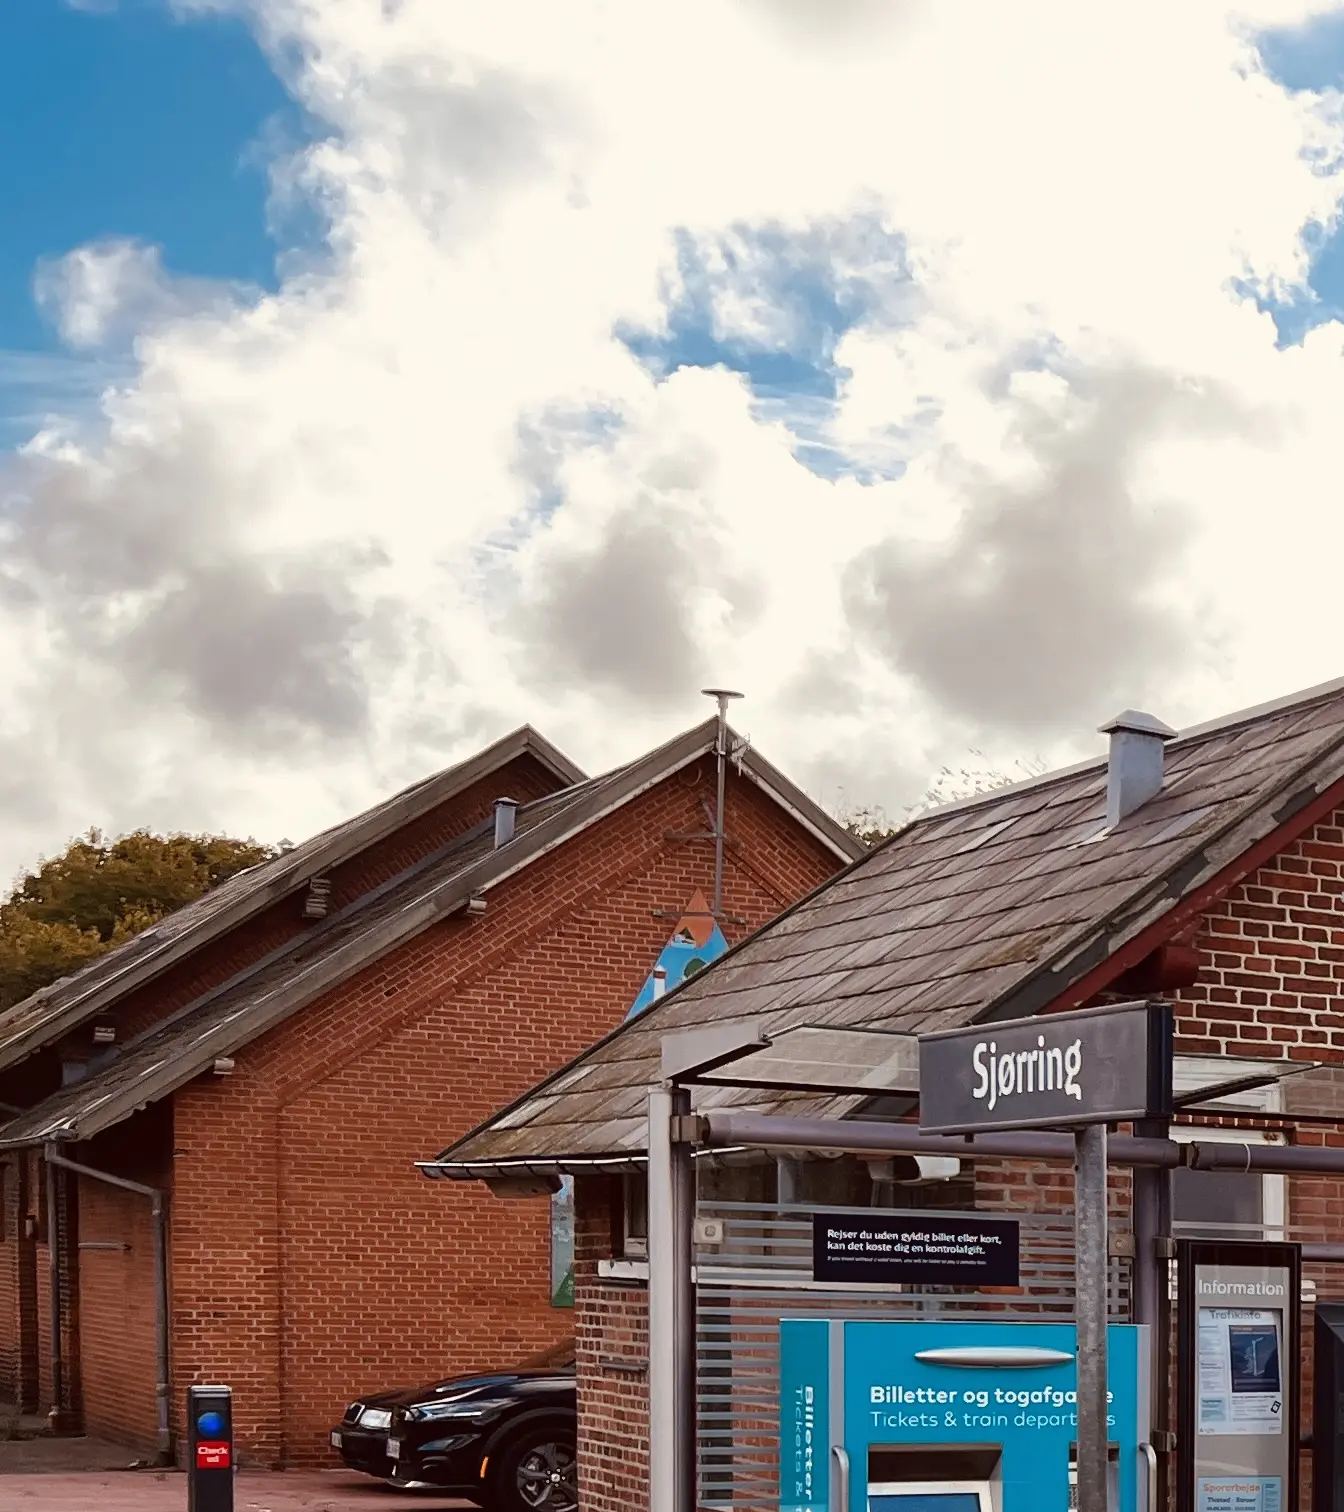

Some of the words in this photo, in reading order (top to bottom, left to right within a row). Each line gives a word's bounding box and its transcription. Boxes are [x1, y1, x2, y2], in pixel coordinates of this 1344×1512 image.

[973, 1035, 1081, 1110] Sjørring
[827, 1229, 857, 1240] Rejser
[859, 1230, 872, 1239] du
[874, 1231, 898, 1240] uden
[901, 1232, 930, 1242] gyldig
[827, 1241, 845, 1250] kan
[847, 1241, 863, 1251] det
[866, 1242, 892, 1252] koste
[894, 1243, 910, 1253] dig
[1199, 1279, 1284, 1296] Information
[870, 1386, 957, 1404] Billetter
[963, 1390, 989, 1407] og
[994, 1386, 1113, 1408] togafgae
[870, 1411, 938, 1427] Tickets
[944, 1411, 958, 1427] &
[963, 1411, 1007, 1427] train
[1014, 1411, 1116, 1430] departs
